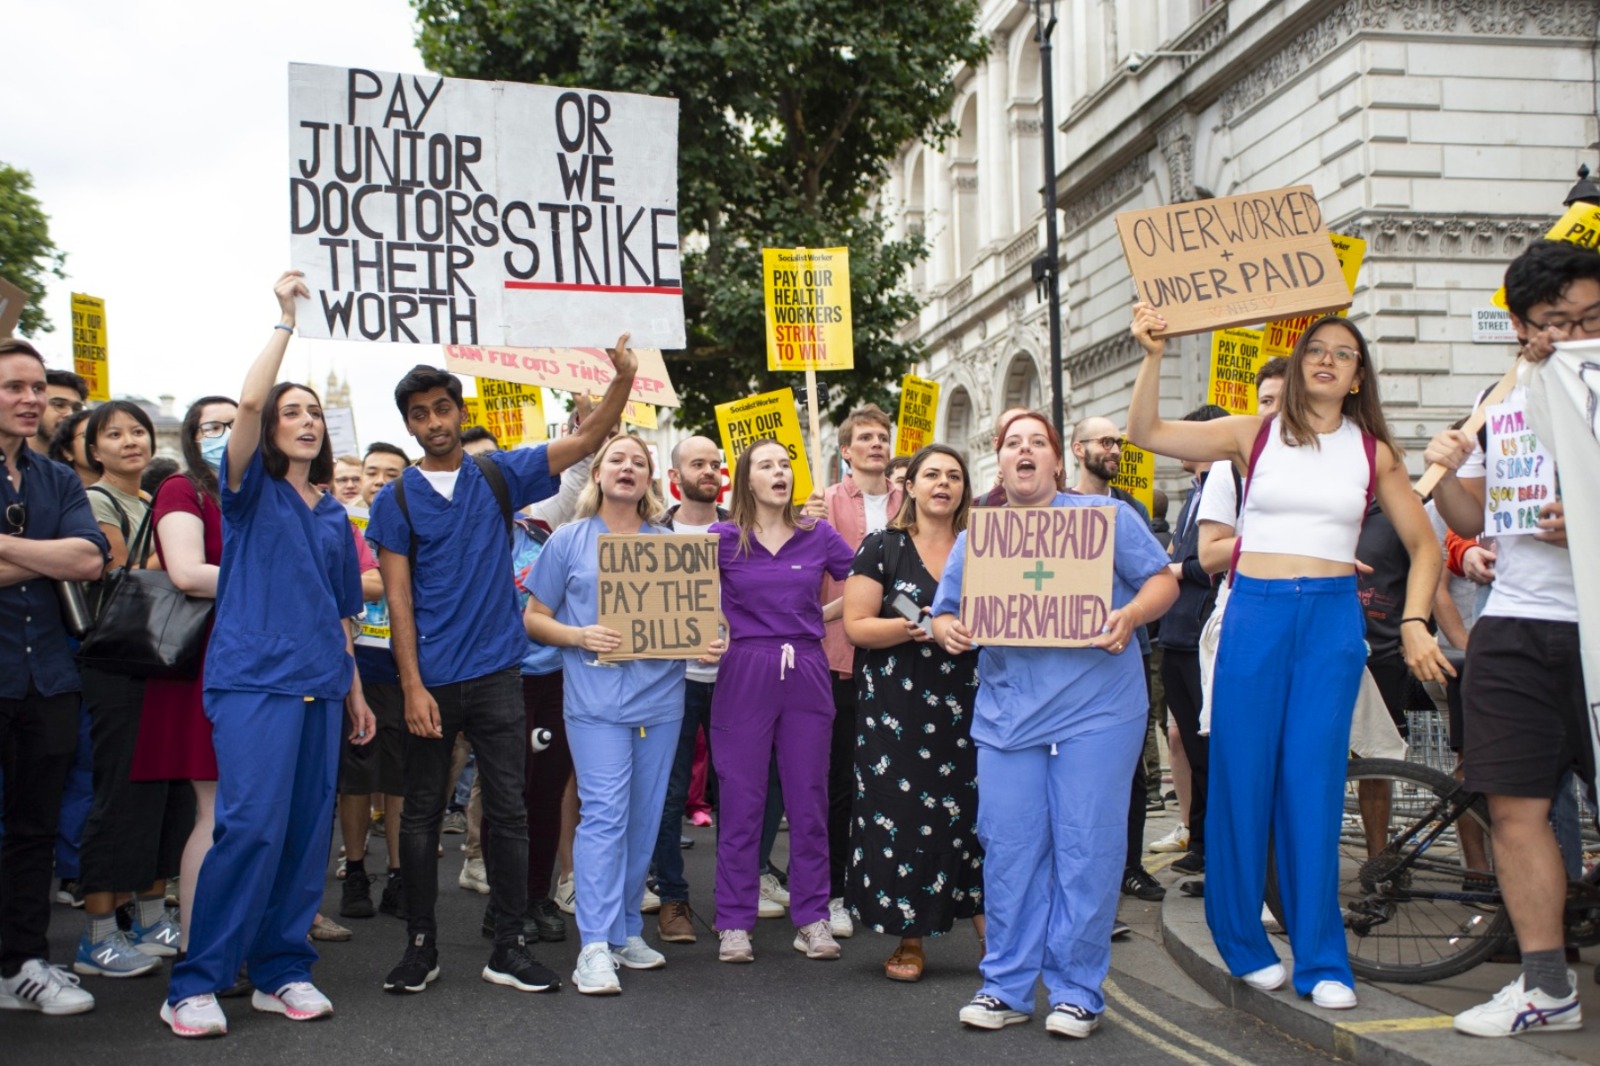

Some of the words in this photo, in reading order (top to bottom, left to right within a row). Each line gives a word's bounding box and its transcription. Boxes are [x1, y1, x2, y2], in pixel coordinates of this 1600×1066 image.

[348, 68, 444, 130] PAY
[555, 92, 613, 155] OR
[299, 121, 483, 191] JUNIOR
[556, 152, 615, 203] WE
[290, 177, 499, 247] DOCTORS
[1133, 191, 1322, 257] OVERWORKED
[502, 201, 681, 287] STRIKE
[1565, 222, 1600, 247] PA
[319, 237, 476, 297] THEIR
[773, 270, 798, 287] PAY
[803, 270, 832, 287] OUR
[774, 288, 824, 306] HEALTH
[774, 305, 843, 324] WORKERS
[1227, 298, 1259, 316] NHS
[319, 290, 478, 345] WORTH
[1478, 321, 1509, 331] STREET
[73, 327, 98, 345] EALTH
[775, 325, 825, 342] STRIKE
[1270, 327, 1283, 346] TO
[74, 343, 106, 361] ORKERS
[776, 343, 794, 361] TO
[798, 343, 827, 361] WIN
[1218, 339, 1237, 353] PAY
[1240, 343, 1258, 358] OUR
[487, 350, 519, 369] FIX
[522, 357, 560, 375] CUTS
[1217, 353, 1251, 370] HEALTH
[1216, 366, 1256, 384] WORKER
[482, 382, 523, 397] HEALTH
[905, 388, 919, 402] PAY
[920, 392, 932, 407] OUR
[1215, 380, 1249, 397] STRIKE
[484, 393, 537, 411] WORKERS
[904, 401, 927, 418] HEALTH
[1215, 393, 1227, 407] TO
[1230, 396, 1248, 410] WIN
[486, 408, 524, 426] STRIKE
[728, 418, 752, 439] PAY
[755, 411, 783, 432] OUR
[903, 414, 932, 432] WORKERS
[1491, 410, 1530, 435] WAN
[488, 425, 502, 438] TO
[505, 423, 527, 437] WIN
[900, 438, 909, 452] TO
[1501, 437, 1518, 456] US
[1520, 434, 1537, 455] TO
[1124, 450, 1143, 464] OUR
[1496, 455, 1544, 479] STAY?
[1111, 474, 1148, 489] ORKERS
[1518, 484, 1547, 502] NEED
[1493, 511, 1512, 533] TO
[970, 509, 1108, 560] UNDERPAID
[600, 541, 658, 573] CLAPS
[600, 580, 650, 615] PAY
[656, 579, 714, 613] THE
[962, 593, 1107, 640] UNDERVALUED
[631, 617, 702, 654] BILLS
